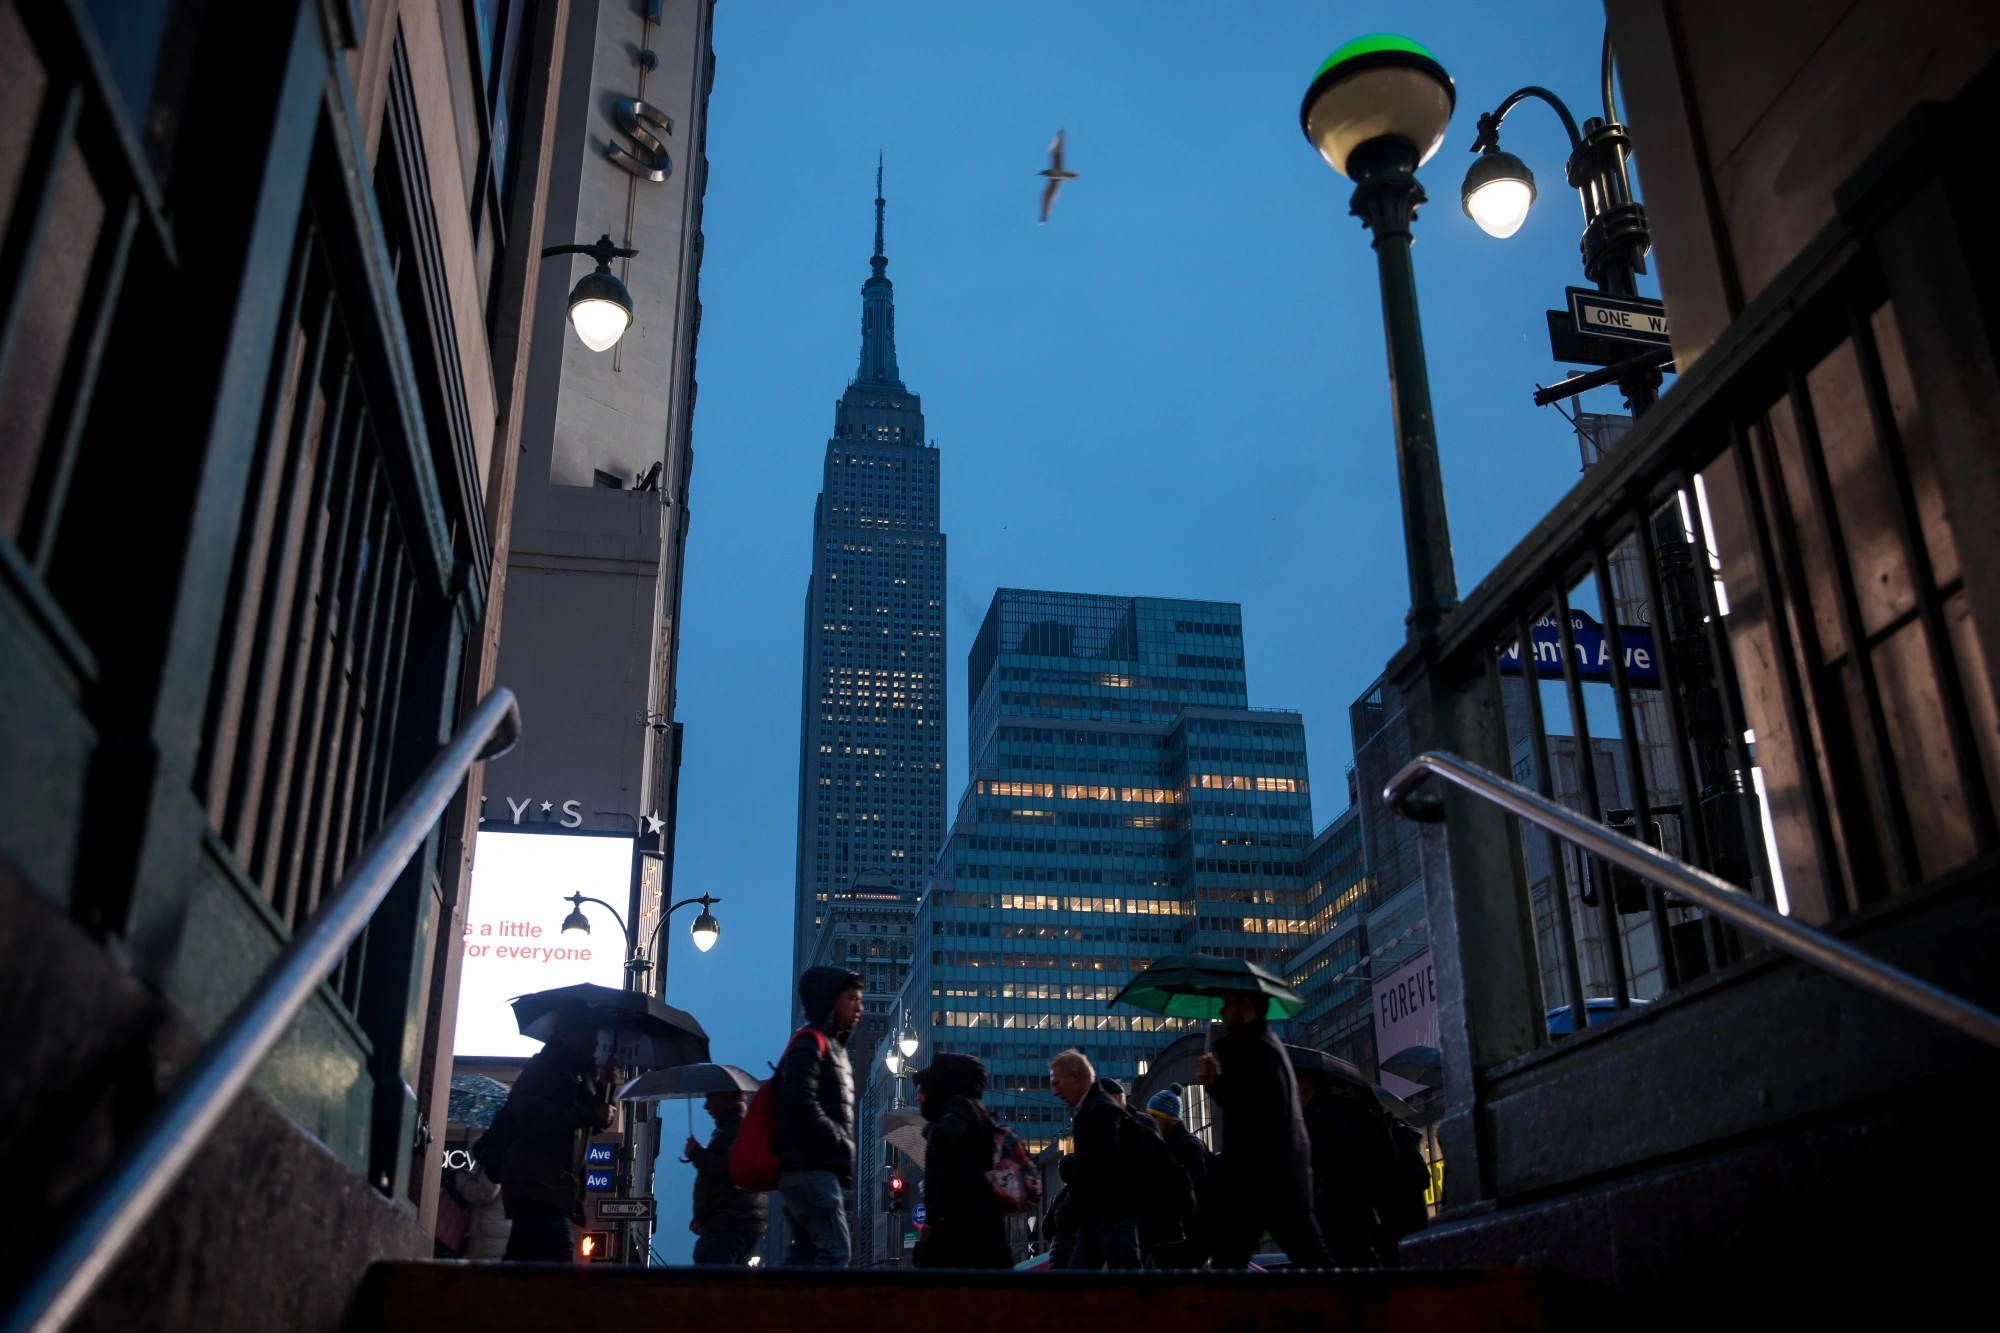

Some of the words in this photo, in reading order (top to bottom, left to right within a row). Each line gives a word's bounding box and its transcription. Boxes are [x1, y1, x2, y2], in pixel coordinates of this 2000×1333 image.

[1597, 309, 1632, 328] ONE
[1597, 639, 1651, 669] Ave
[480, 923, 492, 936] a
[499, 920, 543, 938] little
[462, 941, 490, 957] for
[496, 944, 592, 963] everyone
[1380, 964, 1436, 1029] FOREVE
[589, 1148, 611, 1159] Ave
[586, 1174, 608, 1186] Ave
[606, 1204, 620, 1212] ONE
[627, 1204, 644, 1212] WAY
